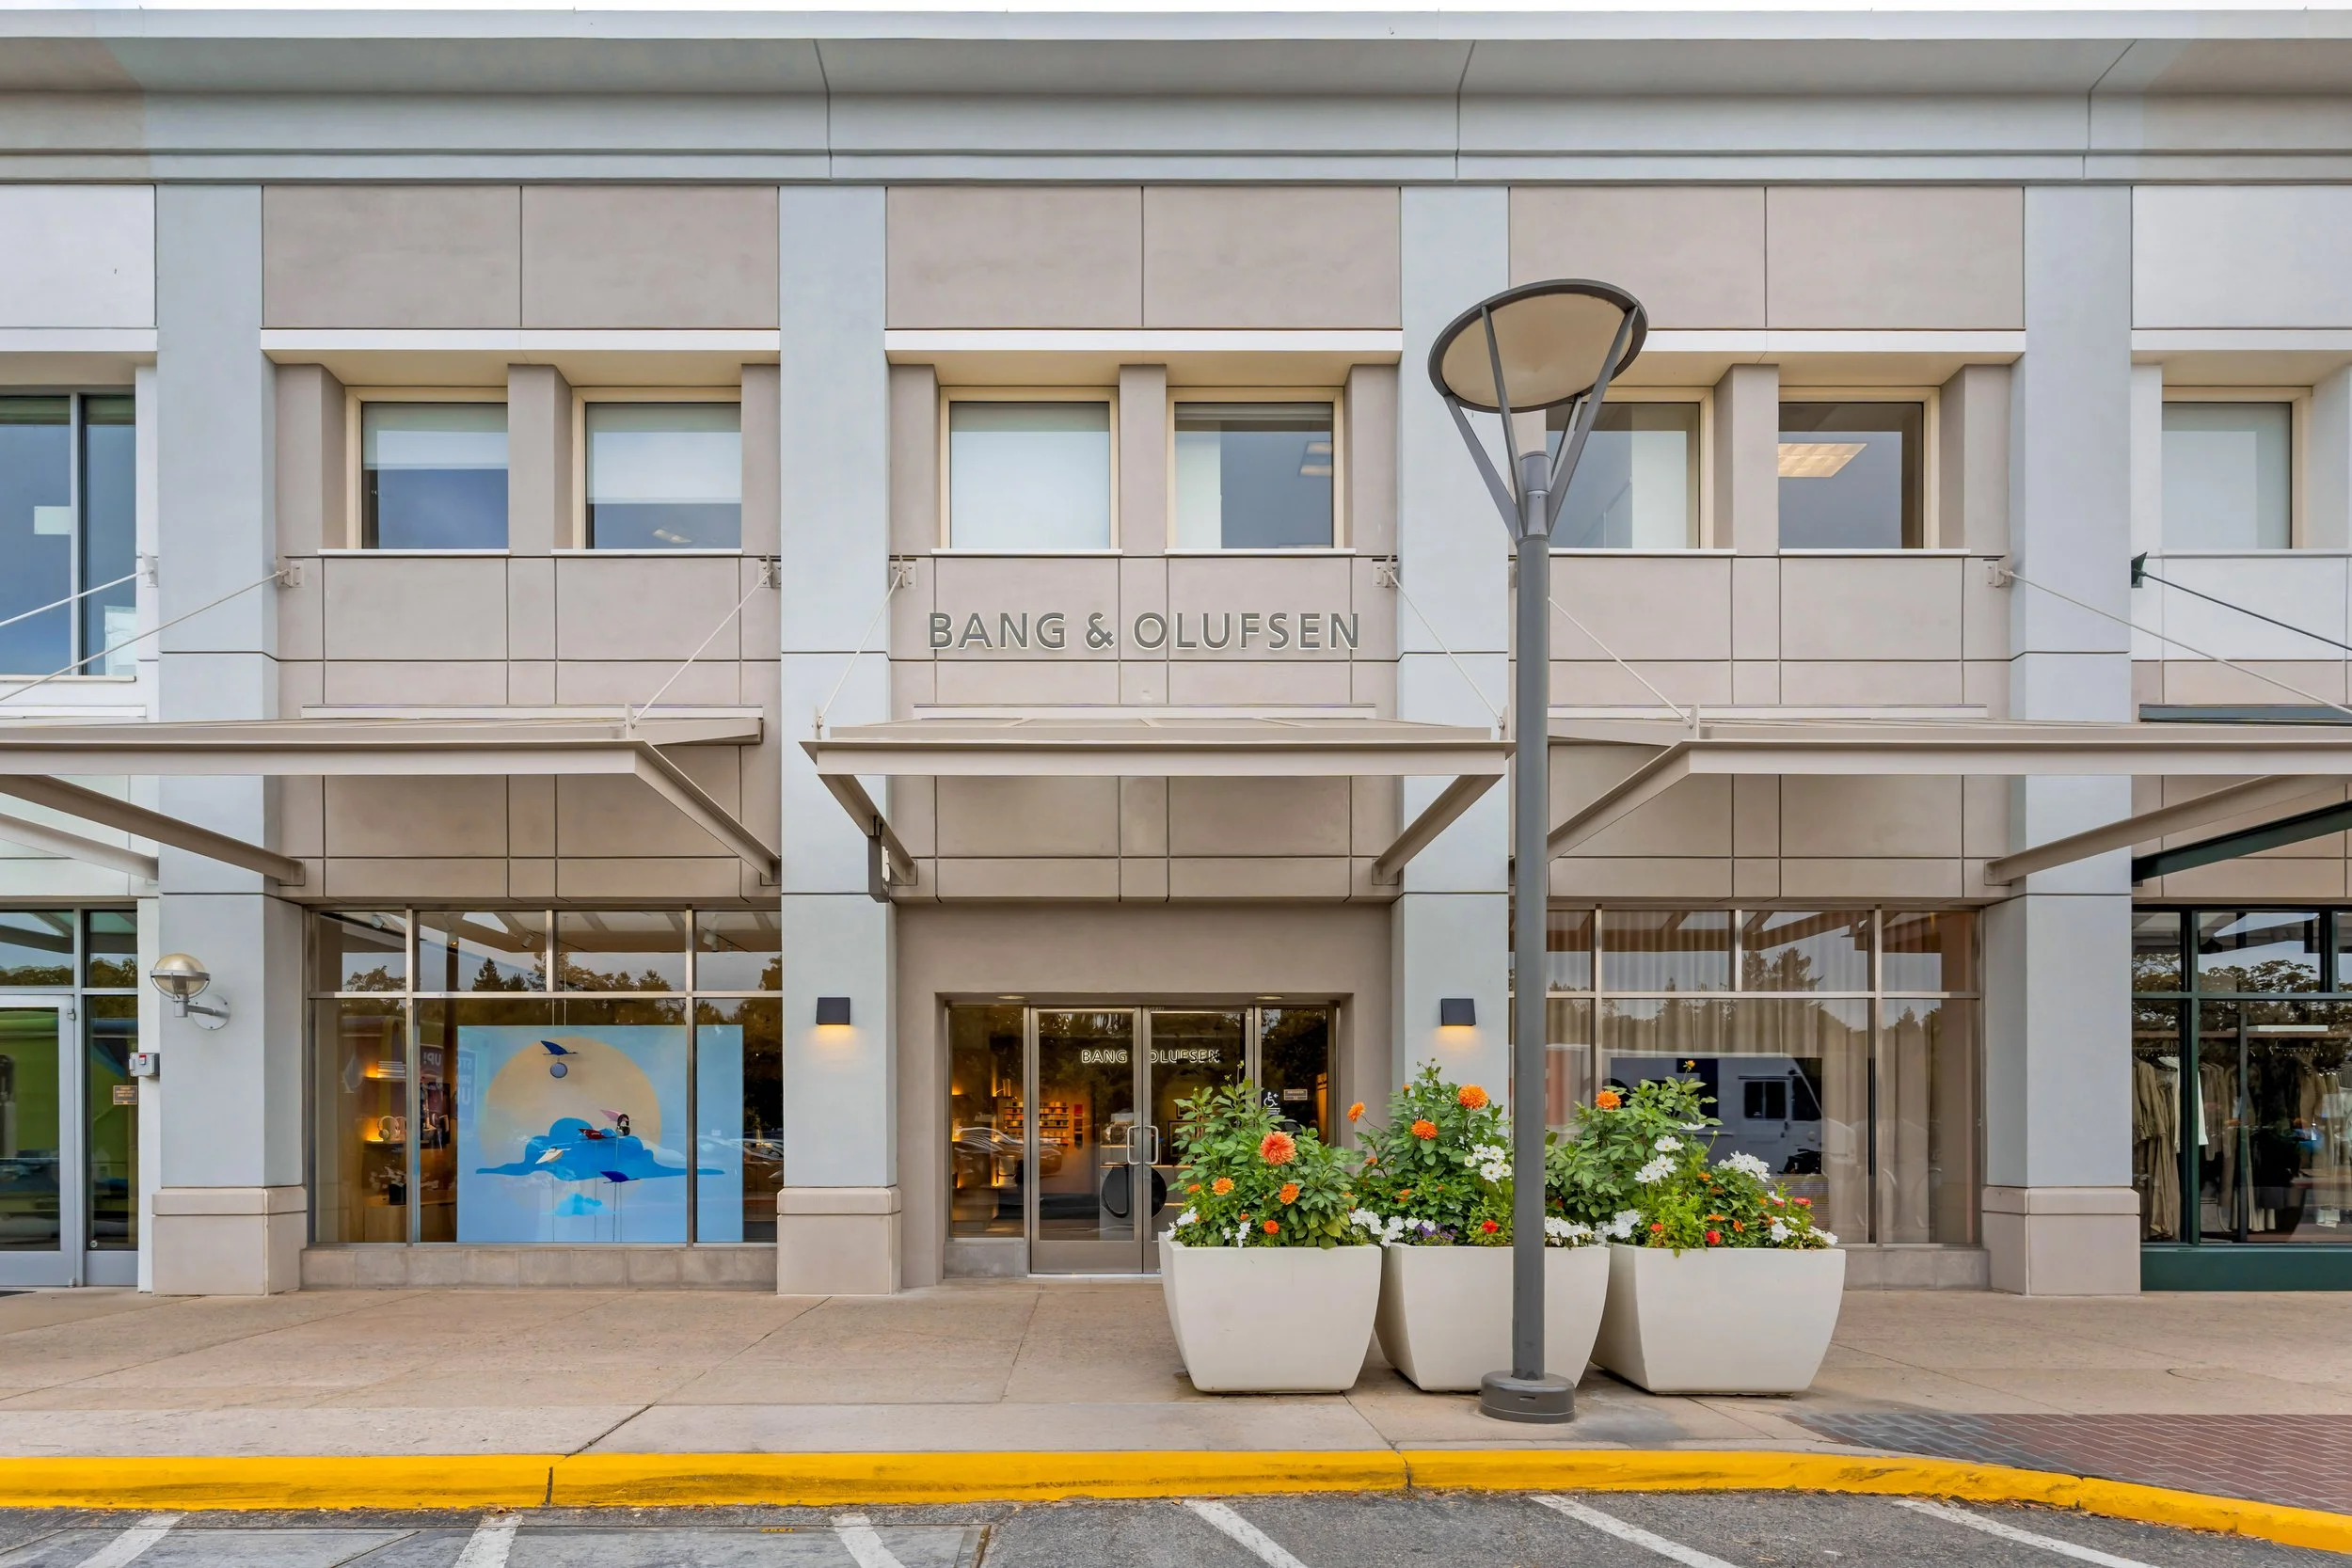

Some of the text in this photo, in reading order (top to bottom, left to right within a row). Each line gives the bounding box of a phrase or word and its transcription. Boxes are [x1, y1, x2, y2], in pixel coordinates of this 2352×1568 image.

[929, 612, 1359, 649] BANG & OLUFSEN
[1082, 1050, 1128, 1063] BANG
